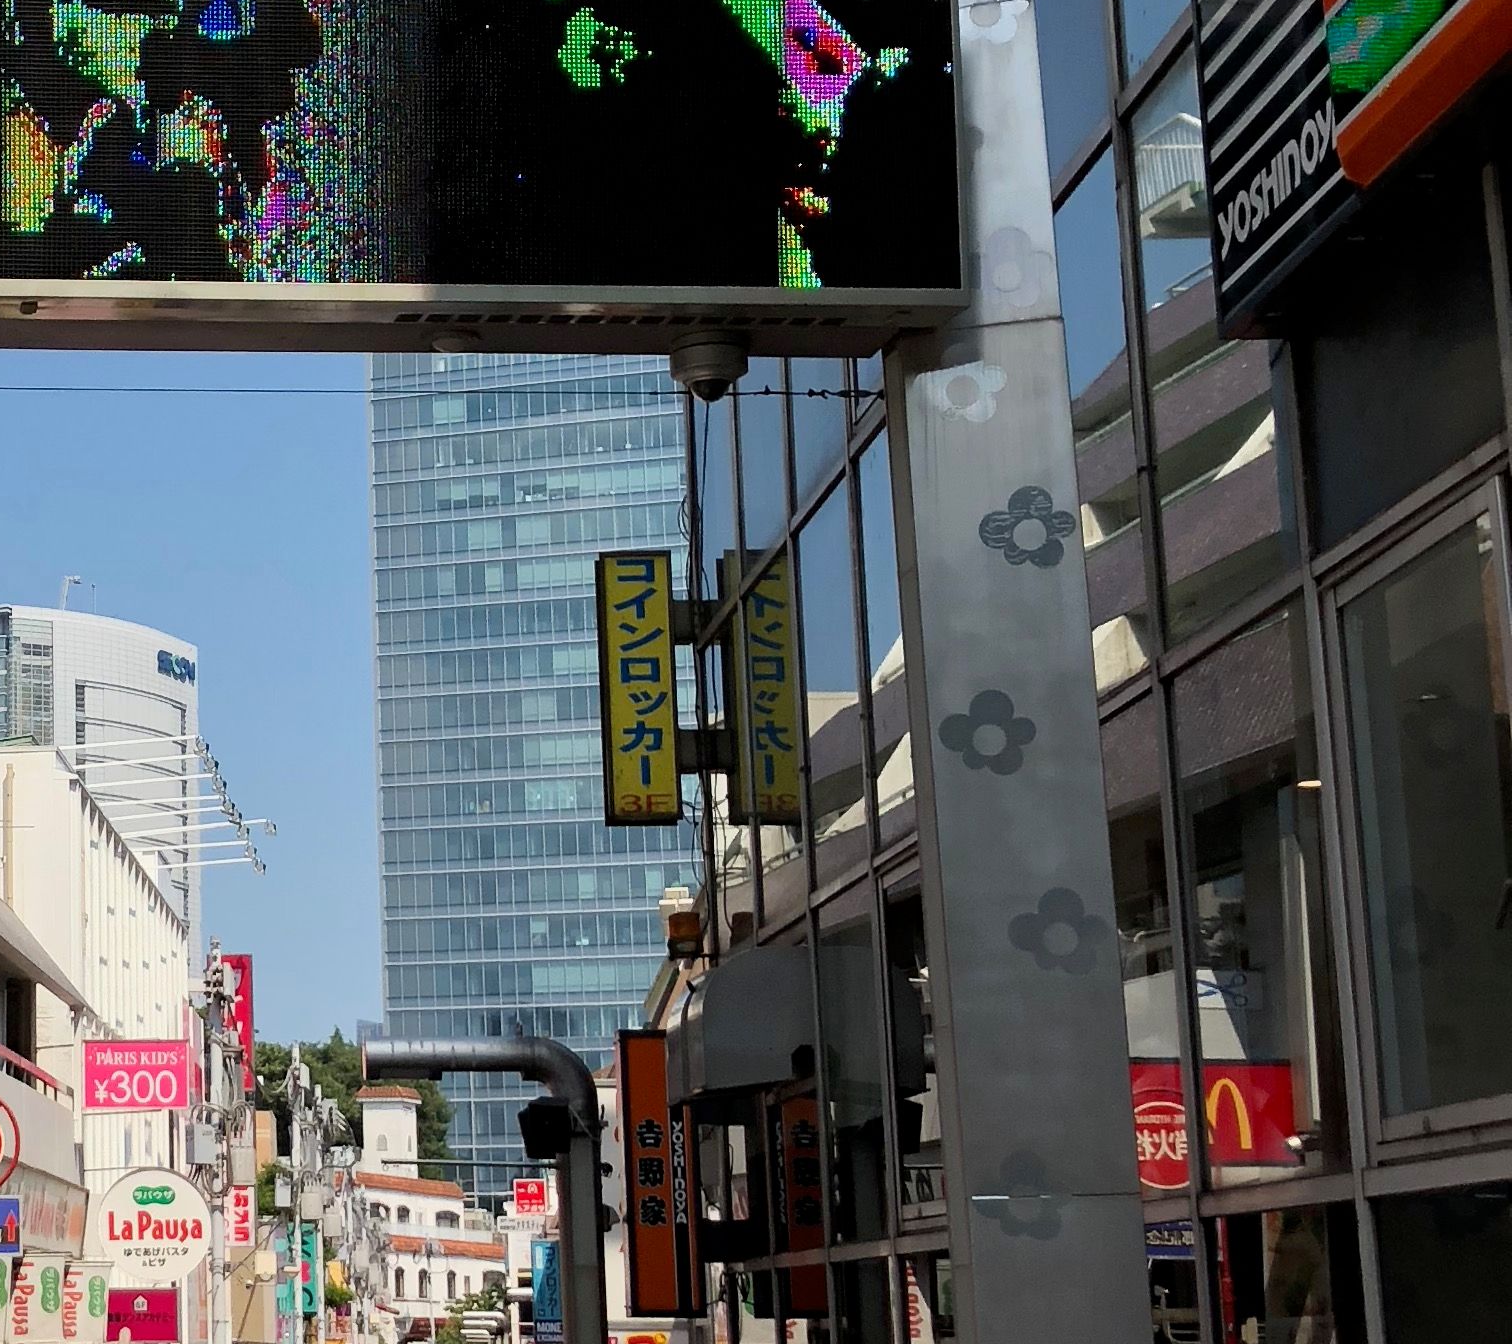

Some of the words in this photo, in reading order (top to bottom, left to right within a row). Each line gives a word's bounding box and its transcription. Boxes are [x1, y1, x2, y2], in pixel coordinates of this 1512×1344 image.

[1217, 99, 1339, 258] YOSHINOY
[614, 559, 668, 786] コインロッカー
[619, 794, 673, 813] 3F
[94, 1070, 177, 1105] ¥300
[95, 1047, 138, 1066] PARIS
[140, 1049, 178, 1065] KID'S
[636, 1117, 667, 1226] 吉野家
